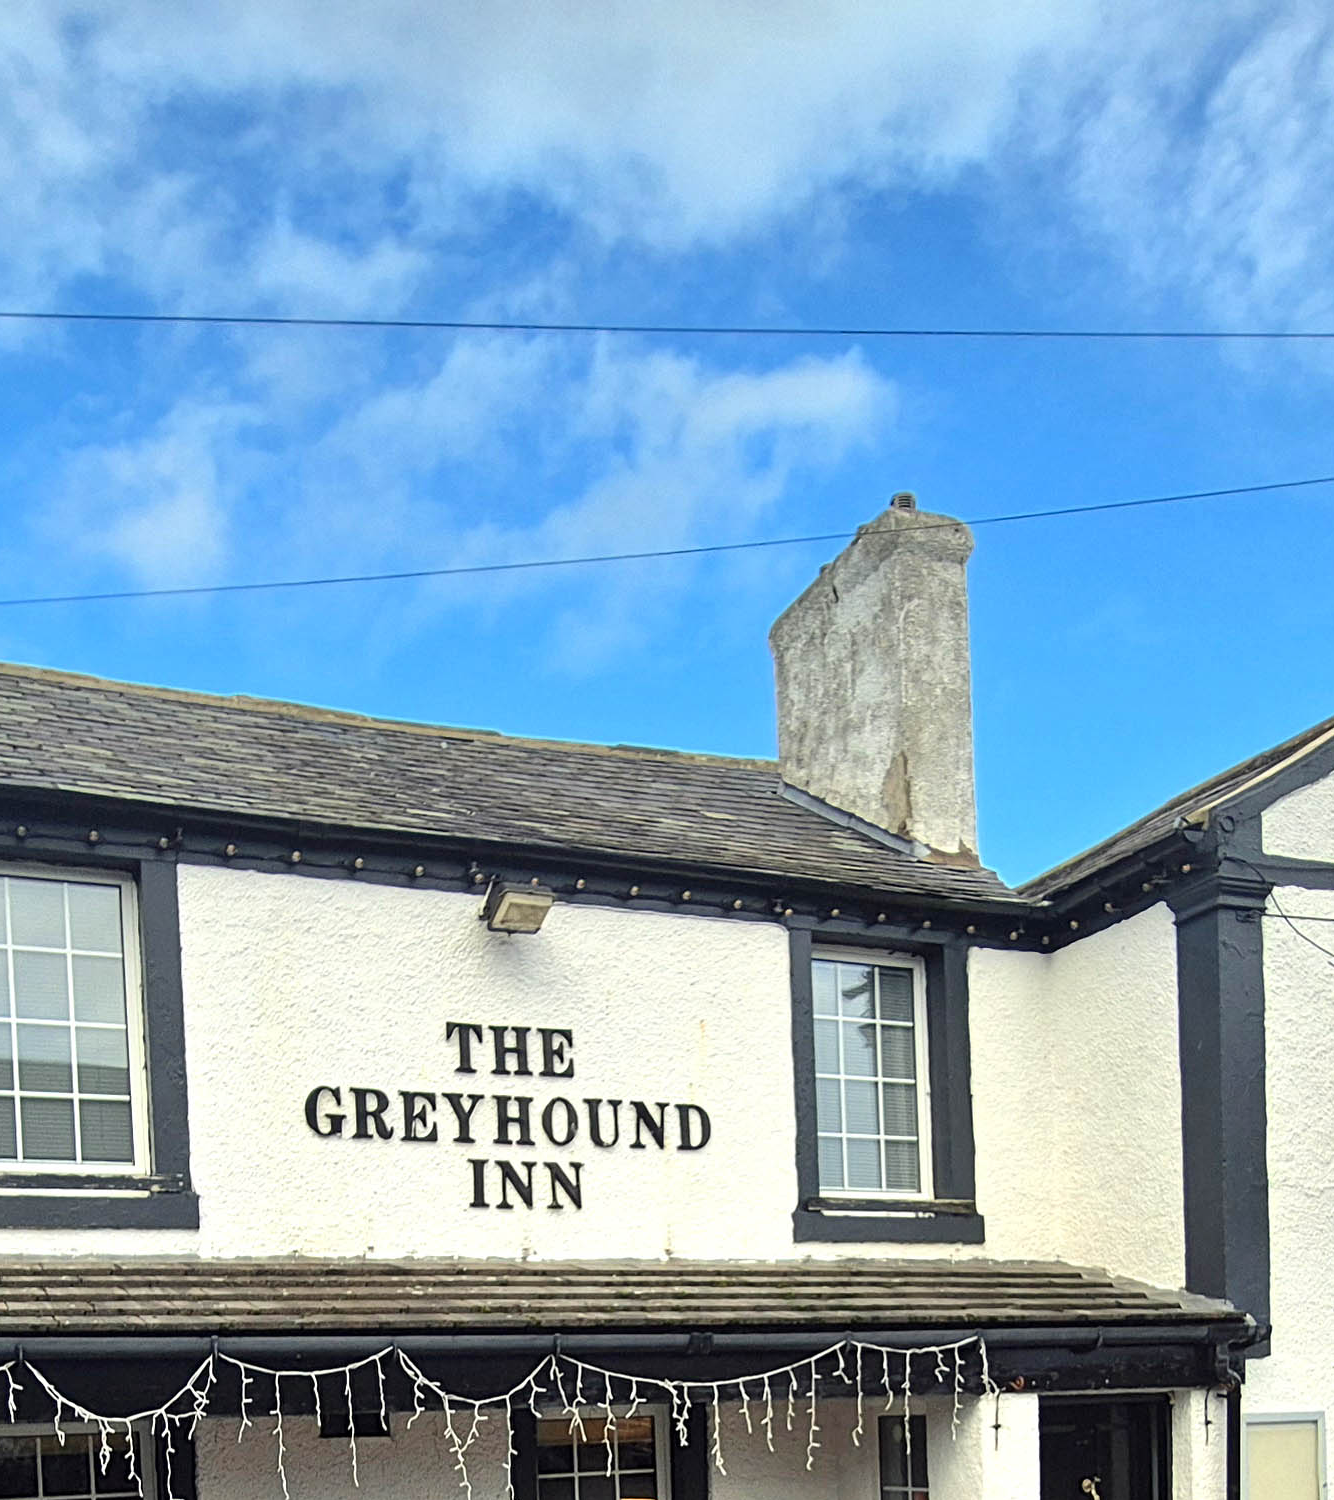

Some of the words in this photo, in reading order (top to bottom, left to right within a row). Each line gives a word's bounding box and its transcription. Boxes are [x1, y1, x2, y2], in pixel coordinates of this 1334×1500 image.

[446, 1021, 575, 1078] THE
[304, 1085, 712, 1151] GREYHOUND
[467, 1159, 584, 1210] INN
